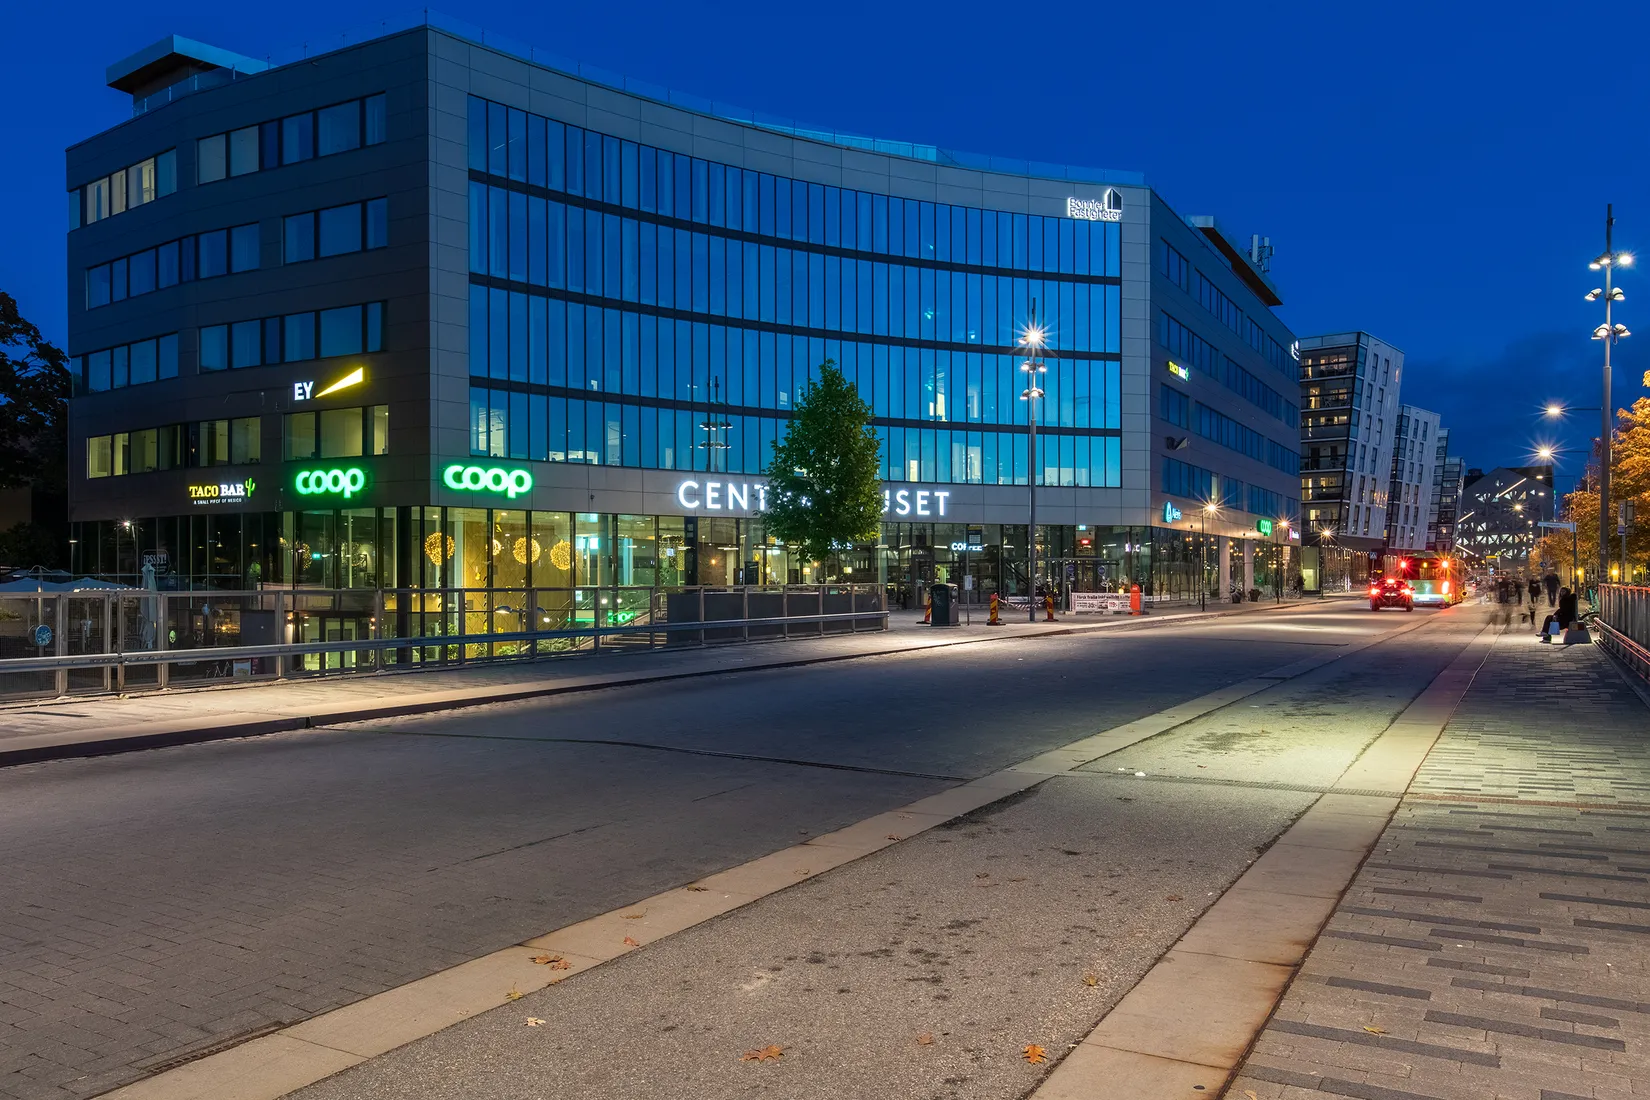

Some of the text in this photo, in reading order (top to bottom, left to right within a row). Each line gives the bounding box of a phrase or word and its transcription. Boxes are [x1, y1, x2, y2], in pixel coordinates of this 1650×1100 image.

[294, 381, 314, 400] EY
[189, 484, 245, 498] TACO BAR
[295, 467, 365, 499] coop
[443, 464, 533, 499] coop
